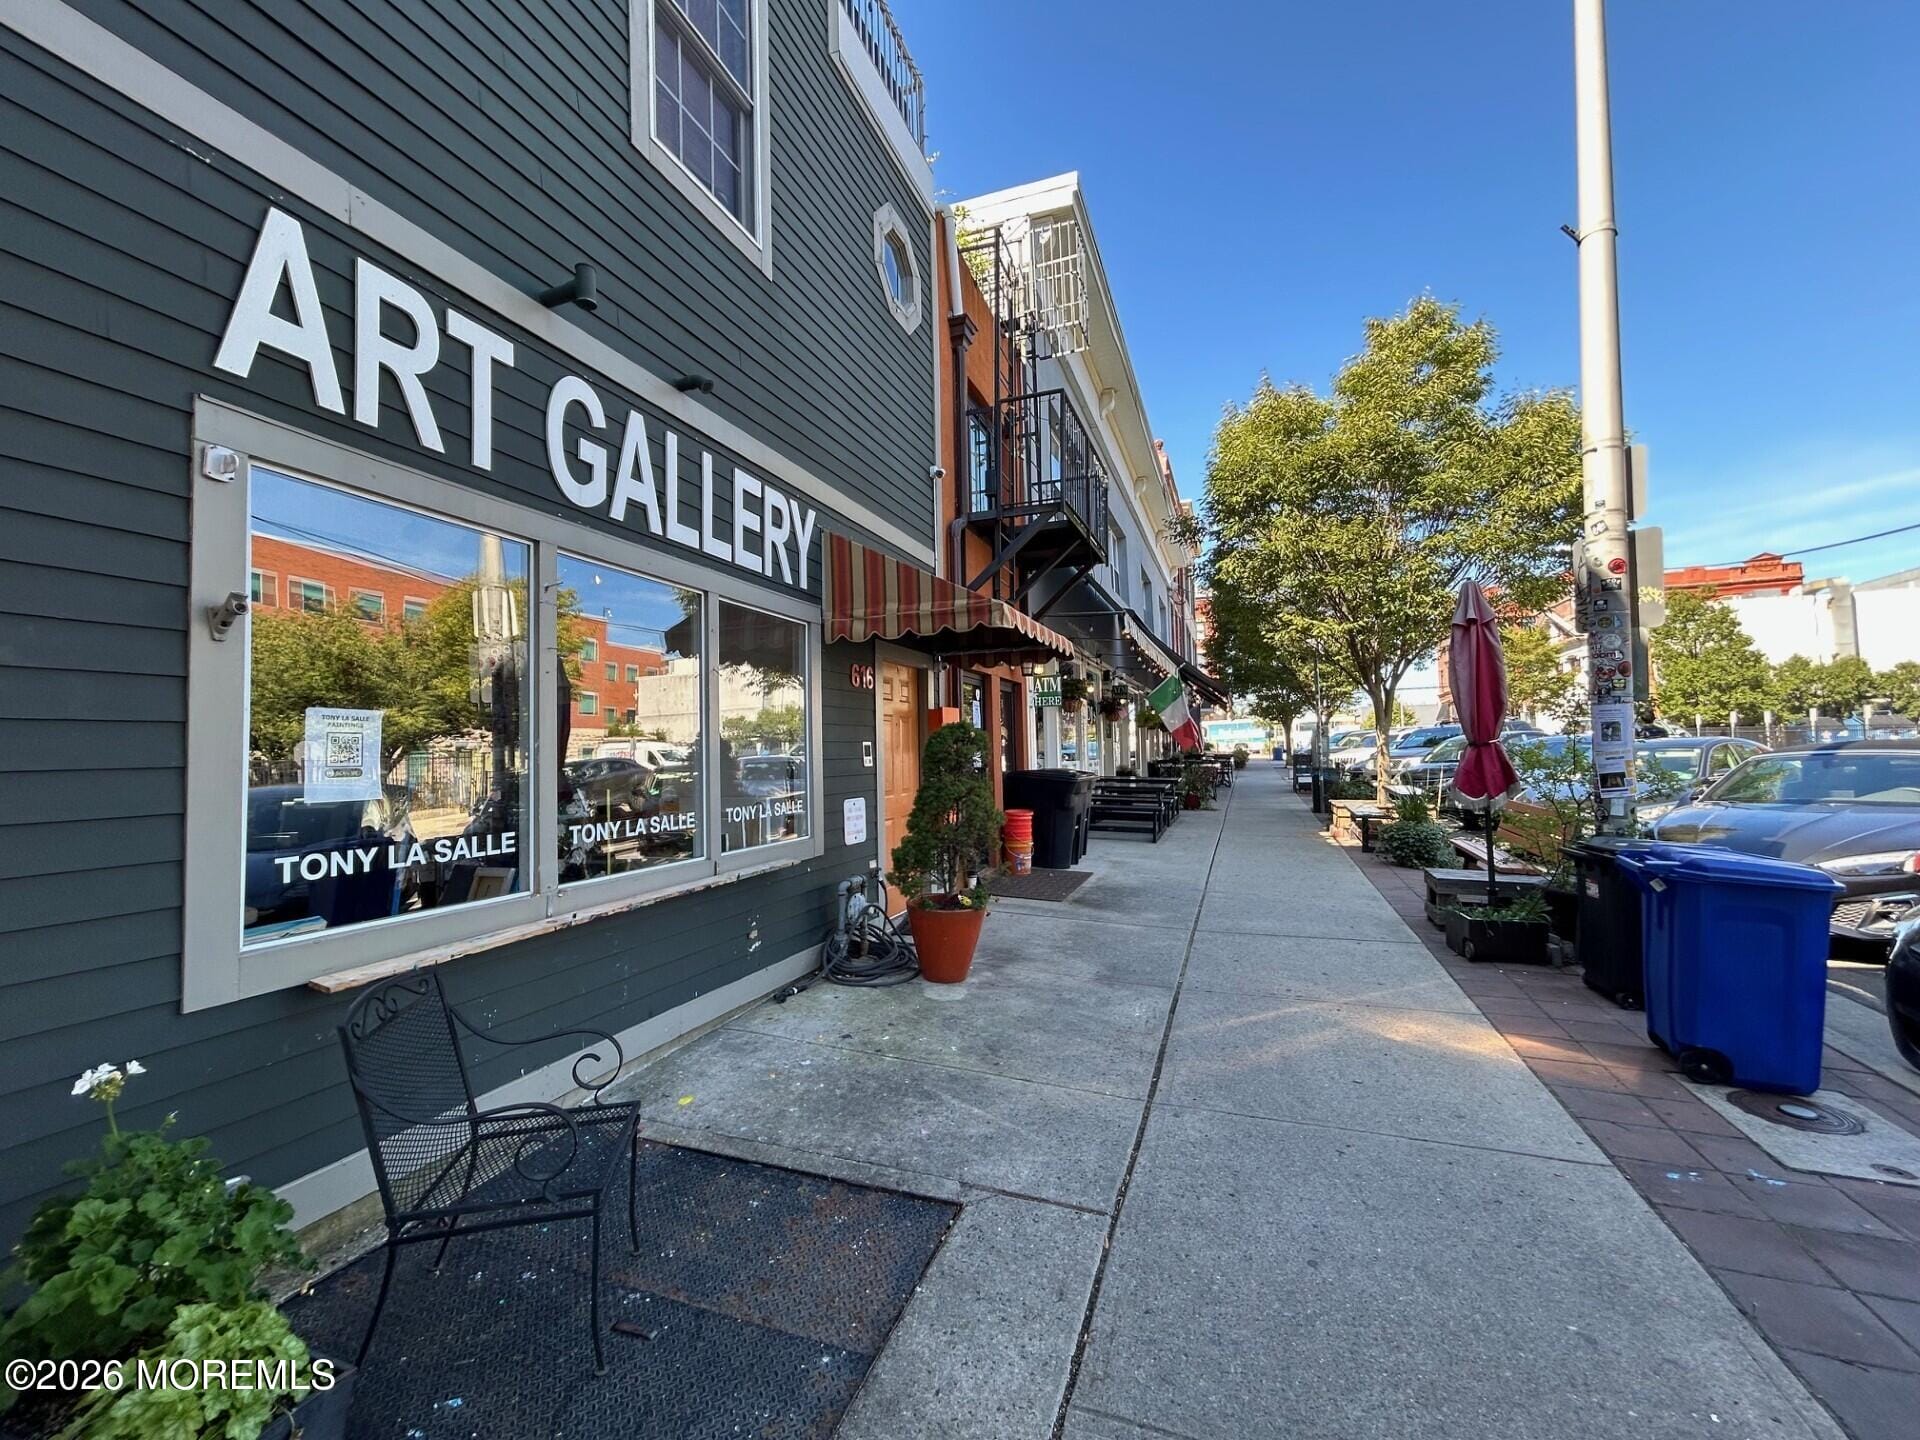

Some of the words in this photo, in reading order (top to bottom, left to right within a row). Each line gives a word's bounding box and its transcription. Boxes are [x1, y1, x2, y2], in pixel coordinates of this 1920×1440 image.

[212, 206, 514, 471] ART
[546, 375, 817, 590] GALLERY
[851, 663, 874, 689] 616
[1034, 676, 1062, 692] ATM
[1034, 696, 1062, 706] HERE
[726, 806, 757, 823] TONY
[759, 804, 772, 818] LA
[774, 800, 804, 816] SALLE
[569, 820, 621, 844] TONY
[625, 820, 647, 837] LA
[650, 812, 696, 834] SALLE
[274, 847, 378, 884] TONY
[388, 841, 427, 869] LA
[434, 832, 516, 863] SALLE
